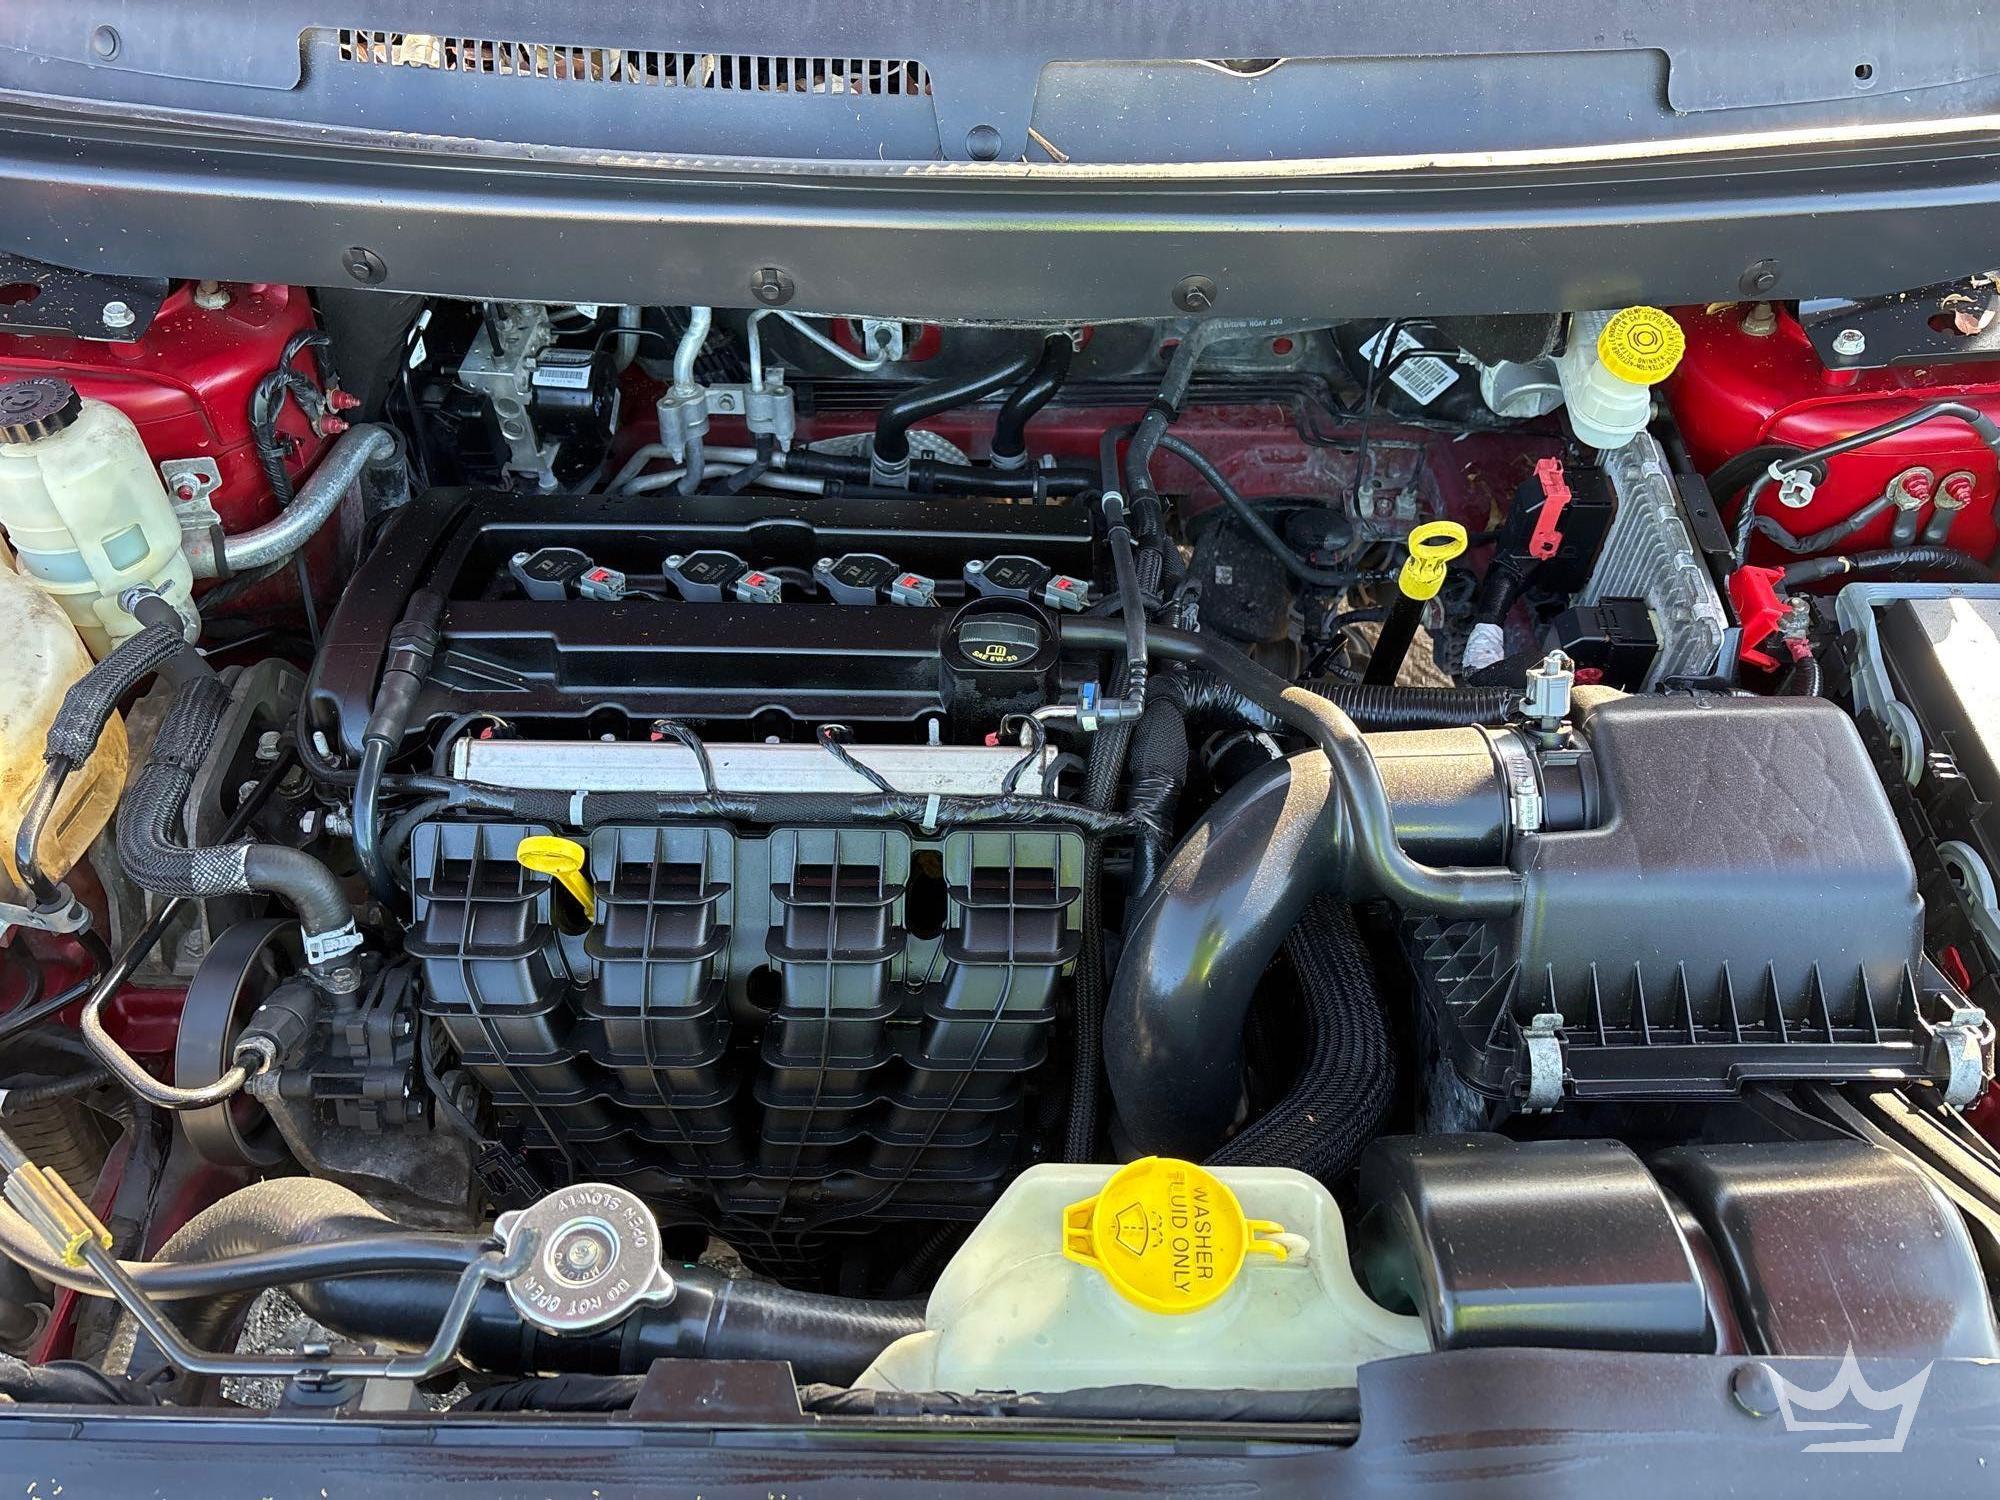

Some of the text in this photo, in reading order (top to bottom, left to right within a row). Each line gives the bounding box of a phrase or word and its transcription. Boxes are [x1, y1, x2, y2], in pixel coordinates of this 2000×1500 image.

[971, 650, 1018, 662] SAE 5W-20
[557, 1191, 649, 1248] OPEN SLOWLY
[1166, 1170, 1192, 1294] FLUID ONLY
[1192, 1186, 1214, 1280] WASHER
[523, 1276, 632, 1316] DO NOT OPEN
